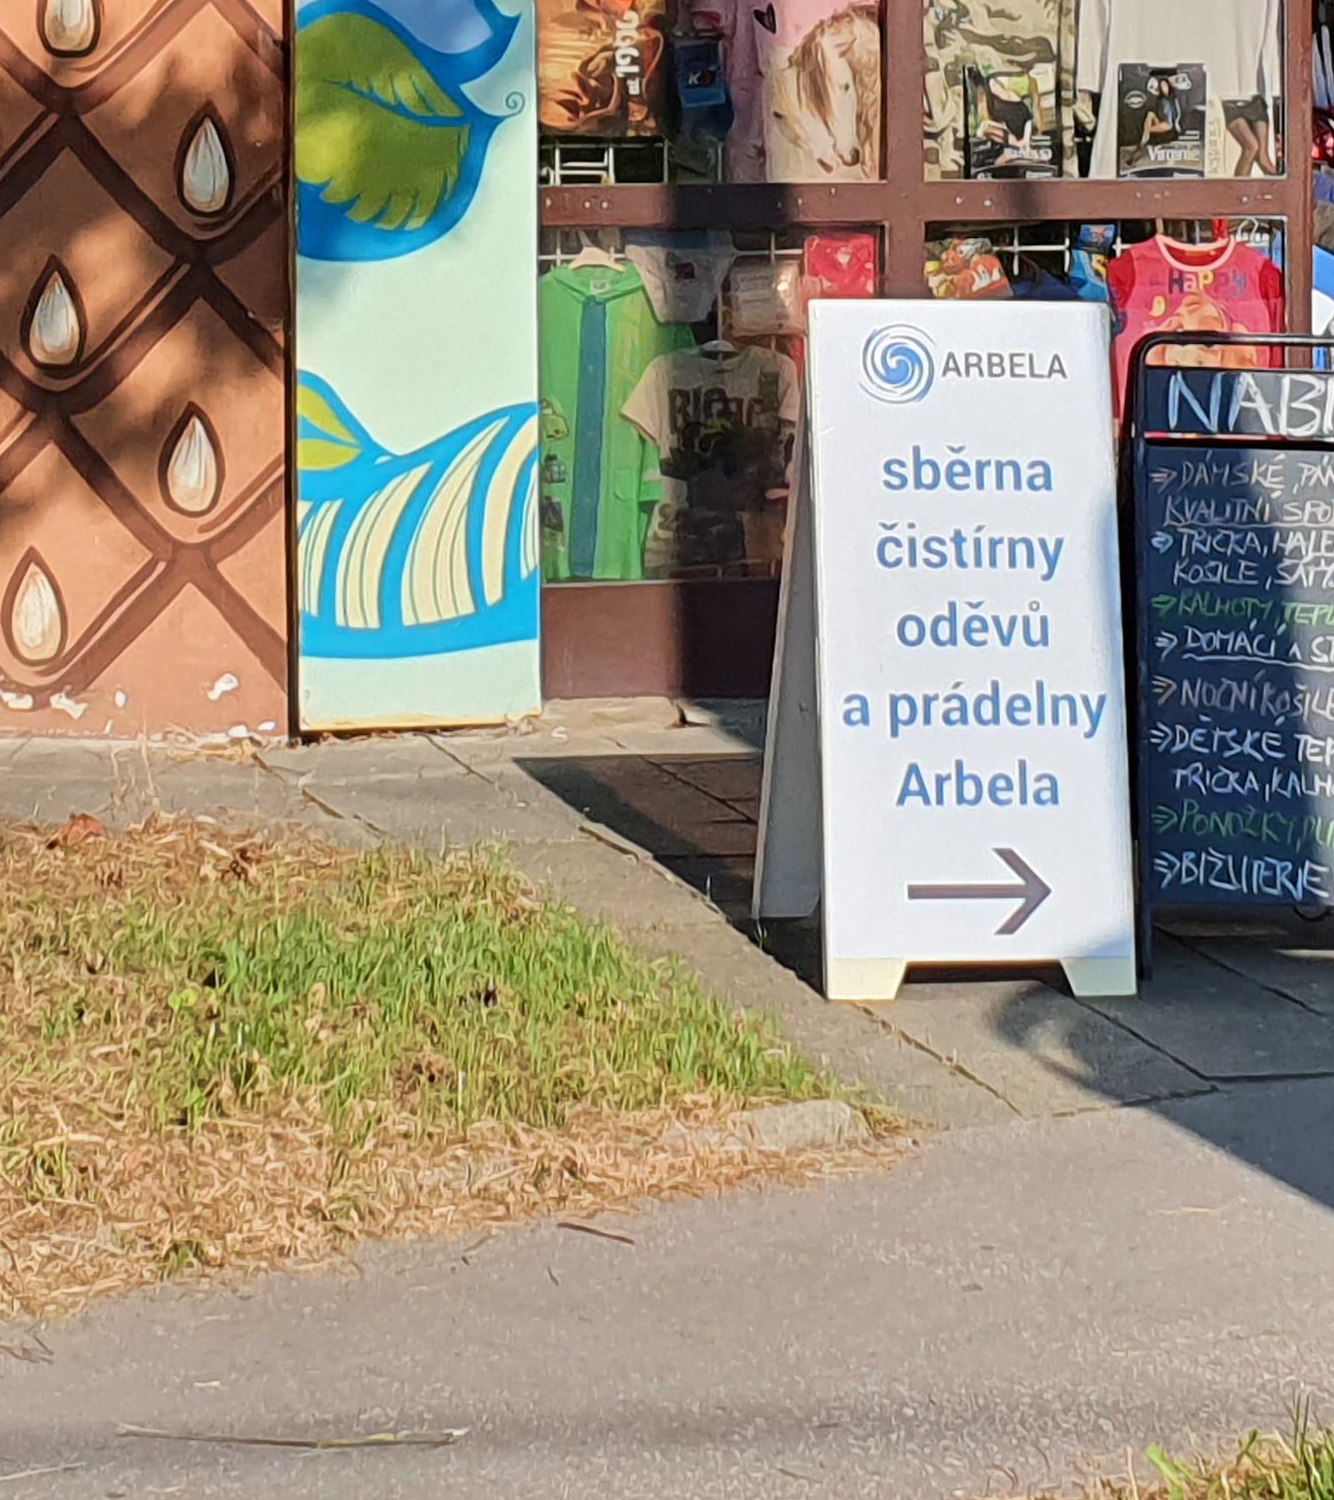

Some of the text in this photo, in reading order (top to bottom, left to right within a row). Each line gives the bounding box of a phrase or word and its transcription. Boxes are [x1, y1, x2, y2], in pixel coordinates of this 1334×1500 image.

[941, 351, 1068, 380] ARBELA
[882, 444, 1053, 491] sběrna
[877, 521, 1064, 580] čistírny
[896, 600, 1050, 648] oděvů
[842, 680, 1107, 738] a prádelny
[896, 760, 1060, 806] Arbela
